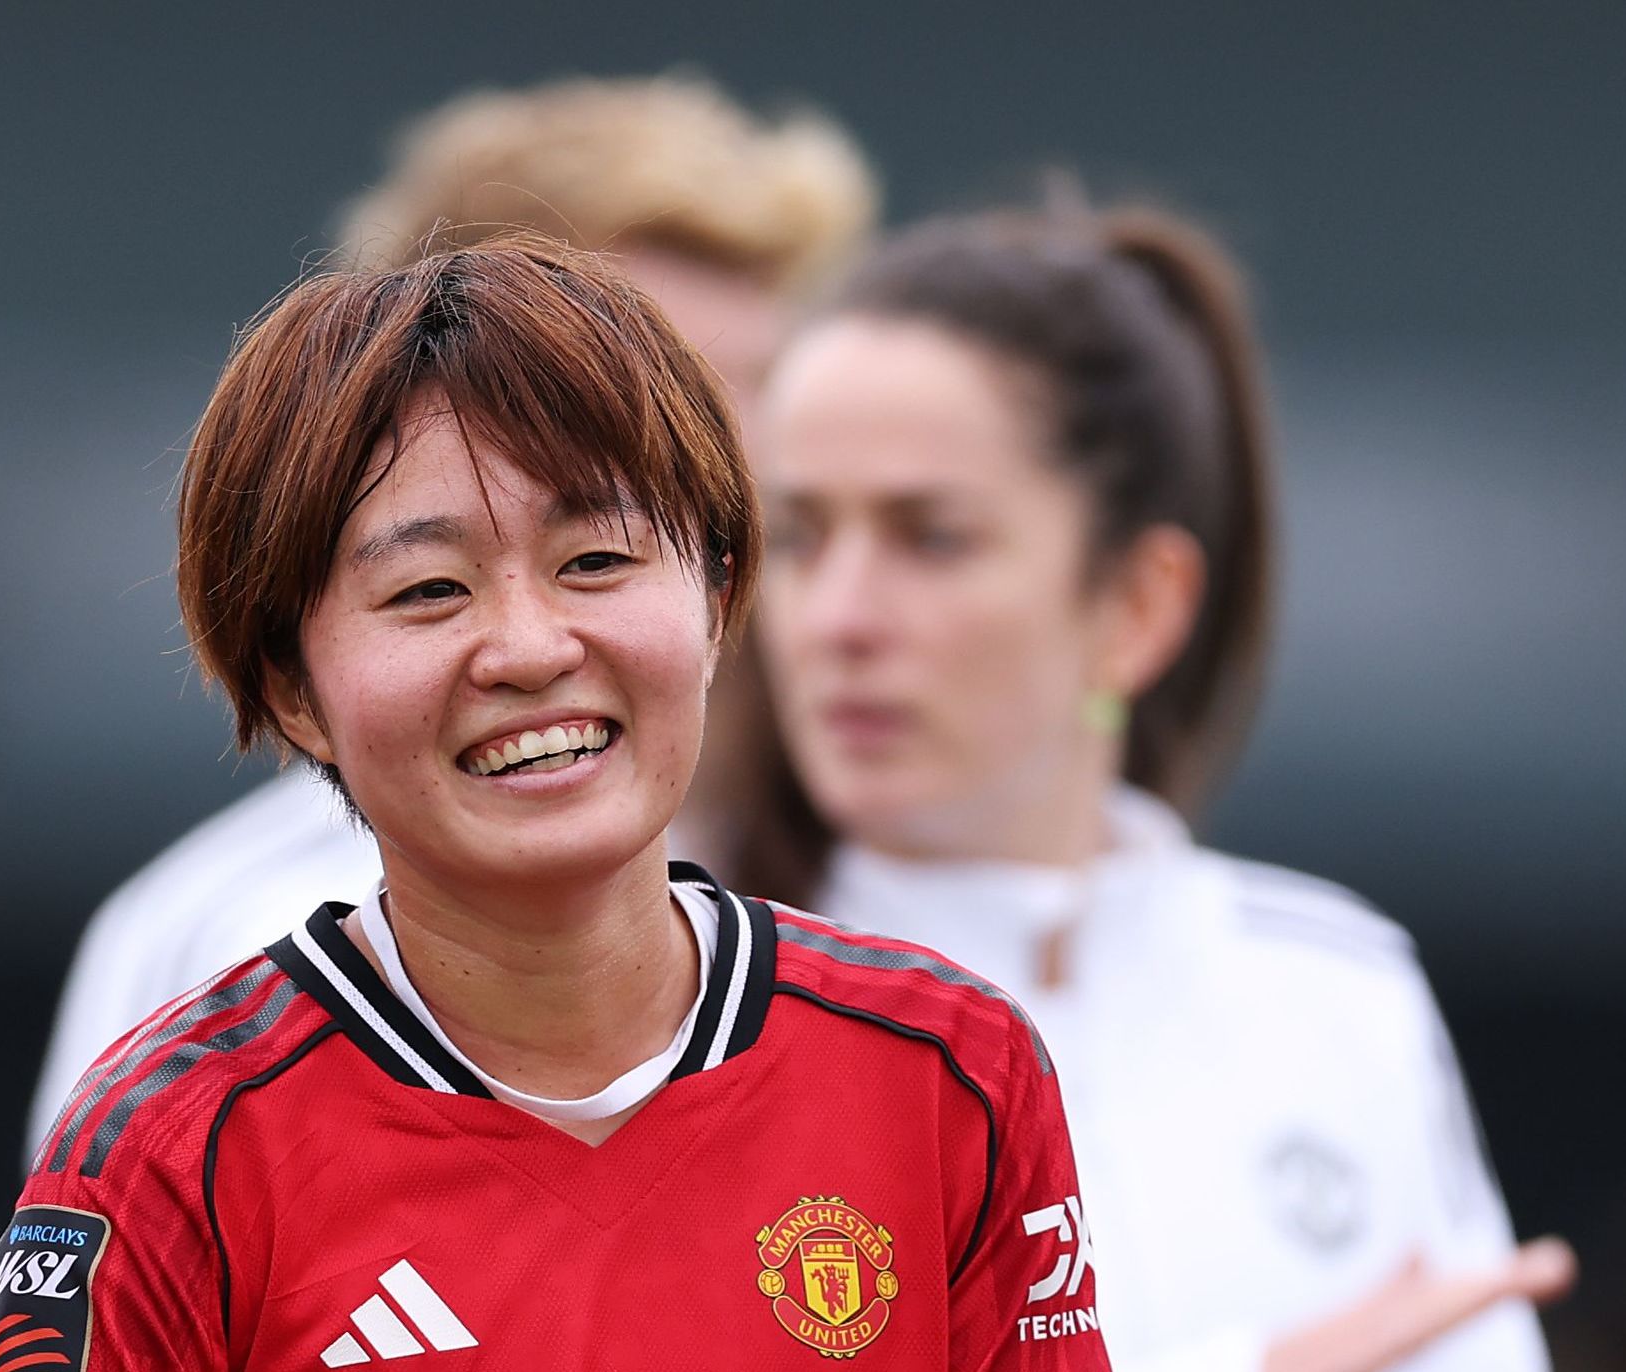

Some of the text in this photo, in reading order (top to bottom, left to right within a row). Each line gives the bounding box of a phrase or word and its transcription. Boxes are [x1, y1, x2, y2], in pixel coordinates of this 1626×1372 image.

[18, 1225, 88, 1247] BARCLAYS
[768, 1208, 883, 1259] MANCHESTER
[799, 1318, 872, 1346] UNITED
[1017, 1306, 1099, 1342] TECHN
